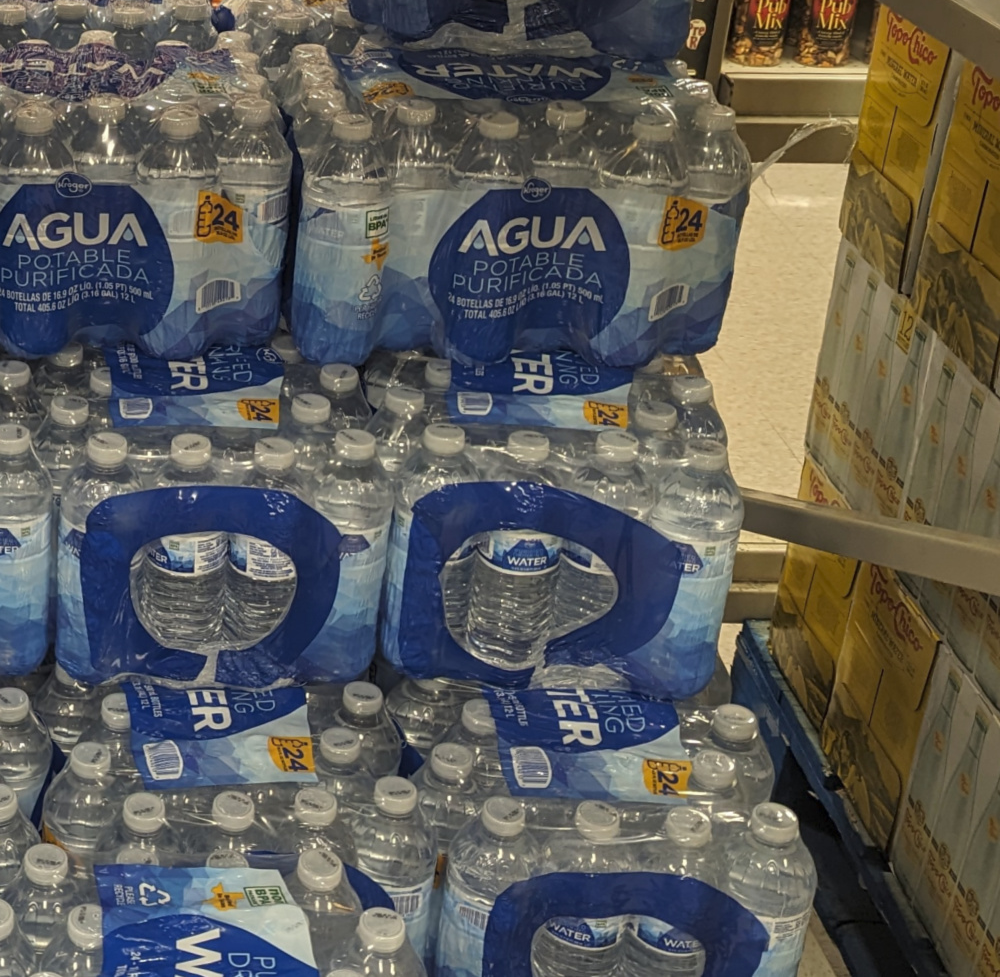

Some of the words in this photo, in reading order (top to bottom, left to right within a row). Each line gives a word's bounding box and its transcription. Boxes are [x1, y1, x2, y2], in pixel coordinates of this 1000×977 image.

[755, 13, 783, 31] Mix
[816, 13, 847, 31] Mix
[213, 204, 239, 230] 24
[677, 207, 702, 233] 24
[3, 212, 148, 250] AGUA
[458, 216, 606, 257] AGUA
[18, 249, 131, 269] POTABLE
[474, 252, 585, 276] POTABLE
[1, 264, 150, 287] PURIFICADA
[452, 267, 602, 294] PURIFICADA
[6, 290, 40, 302] BOTELLAS
[42, 292, 52, 301] DE
[53, 288, 67, 300] 16.9
[68, 285, 78, 296] OZ
[95, 281, 114, 290] (1.05
[115, 282, 127, 292] PT)
[129, 286, 141, 296] 500
[142, 290, 153, 300] mL
[14, 302, 36, 313] TOTAL
[37, 302, 56, 312] 405.6
[57, 300, 66, 309] OZ
[101, 290, 119, 300] GAL)
[121, 292, 129, 300] 12
[507, 556, 547, 566] WATER
[282, 749, 304, 772] 24
[657, 774, 679, 796] 24
